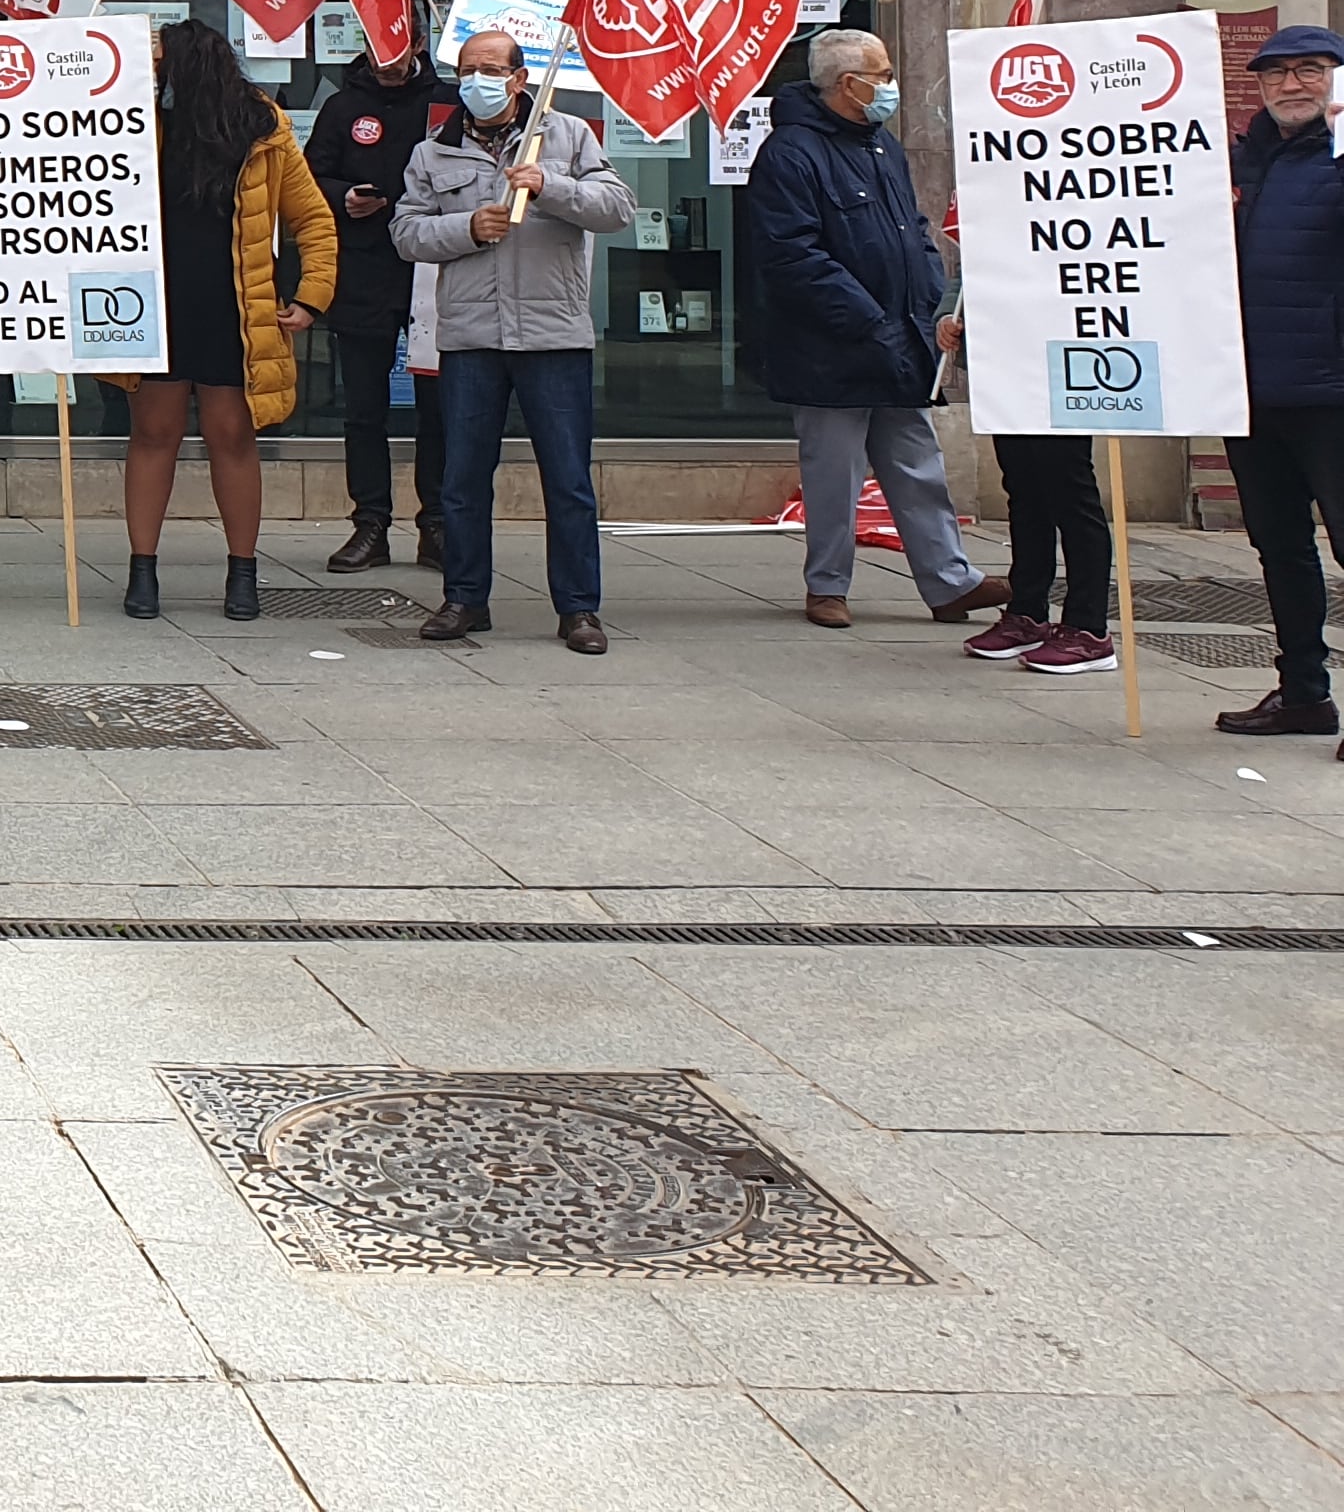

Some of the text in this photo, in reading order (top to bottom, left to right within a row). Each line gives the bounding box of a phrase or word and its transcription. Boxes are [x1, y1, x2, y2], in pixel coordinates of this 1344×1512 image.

[47, 51, 94, 65] Castilla
[48, 64, 90, 80] y León
[1002, 54, 1062, 82] UGT
[1090, 59, 1146, 76] Castilla
[1090, 73, 1141, 94] y León
[22, 107, 146, 139] SOMOS
[969, 119, 1211, 163] ¡NO SOBRA
[1023, 164, 1175, 202] NADIE!
[1031, 216, 1165, 251] NO AL
[20, 280, 57, 304] AL
[1059, 261, 1141, 295] ERE
[81, 286, 145, 327] DO
[27, 316, 65, 340] DE
[83, 330, 145, 342] DOUGLAS
[1075, 305, 1130, 339] EN
[1063, 346, 1143, 392] DO
[1066, 395, 1143, 411] DOUGLAS
